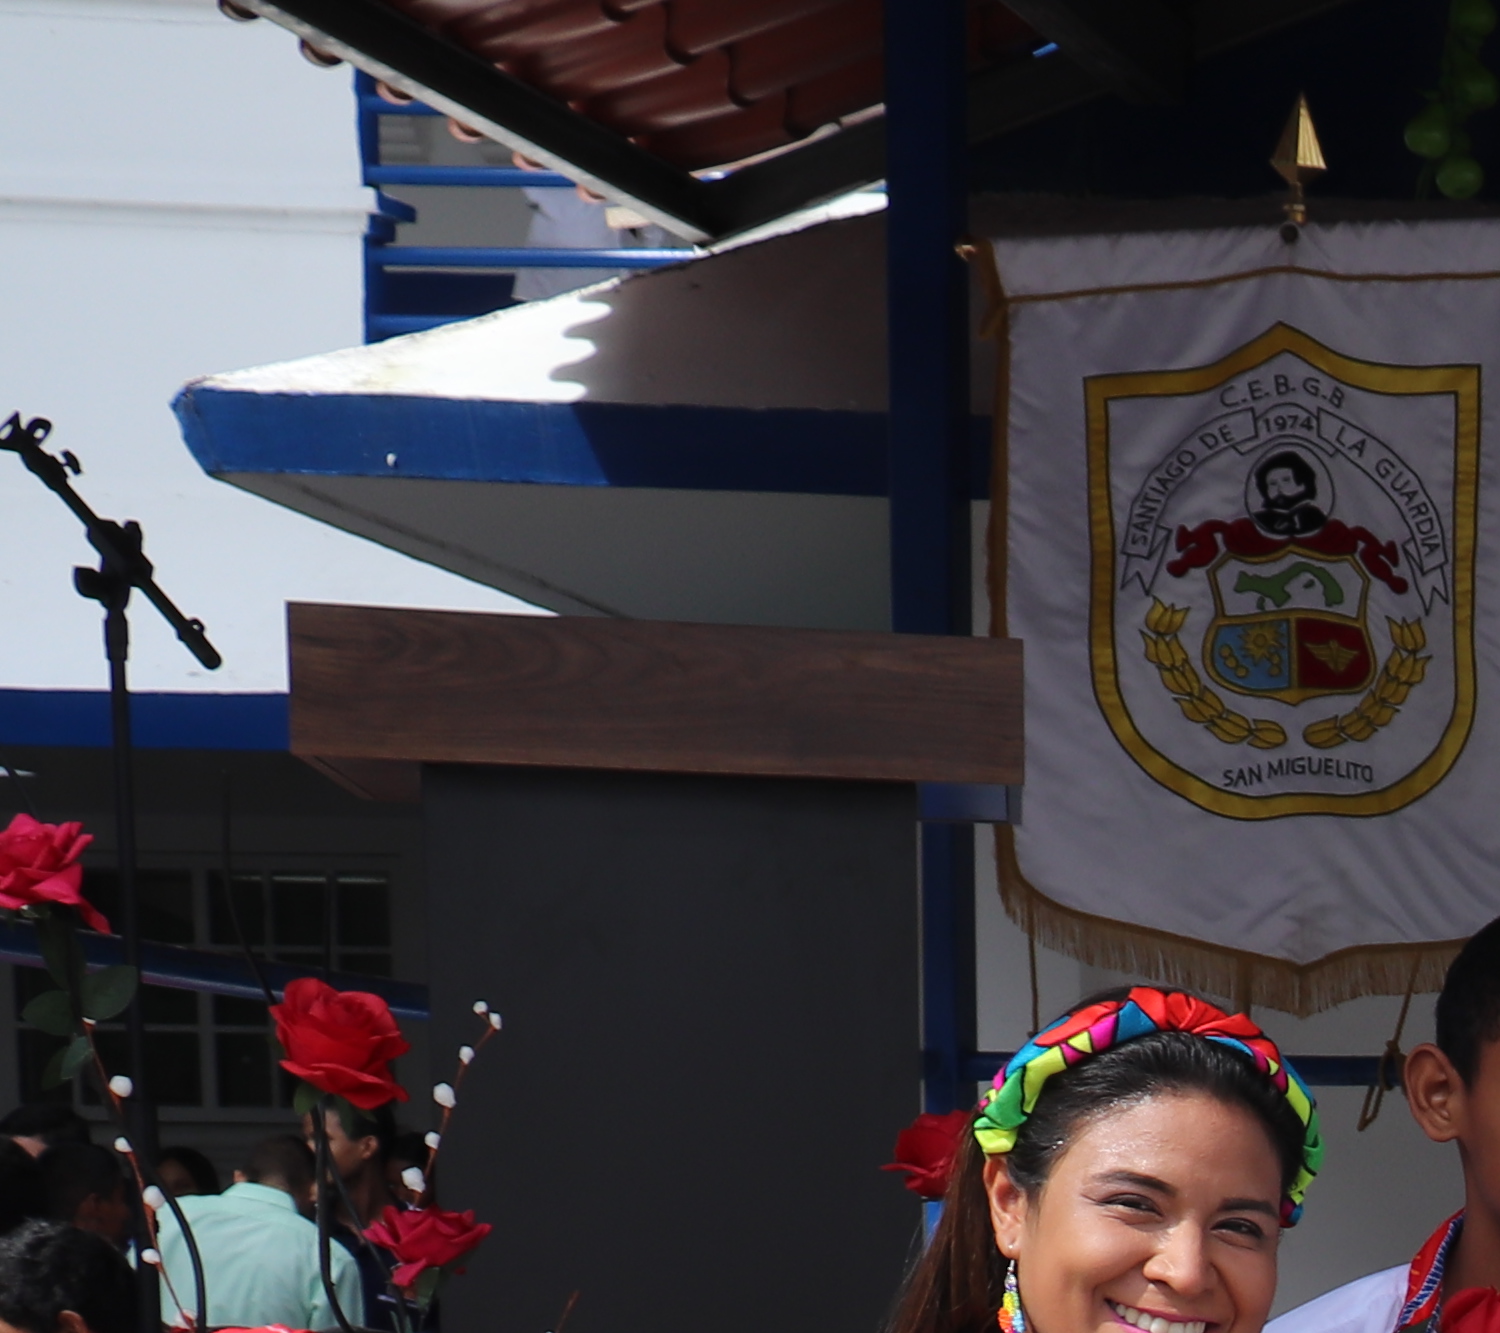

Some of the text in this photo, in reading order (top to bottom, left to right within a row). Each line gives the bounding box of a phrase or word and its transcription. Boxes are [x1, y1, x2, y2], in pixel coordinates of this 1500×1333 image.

[1263, 414, 1314, 434] 1974
[1131, 424, 1442, 558] SANTIAGO DE LA GUARDIA
[1223, 755, 1374, 788] SAN MIGUELITO
